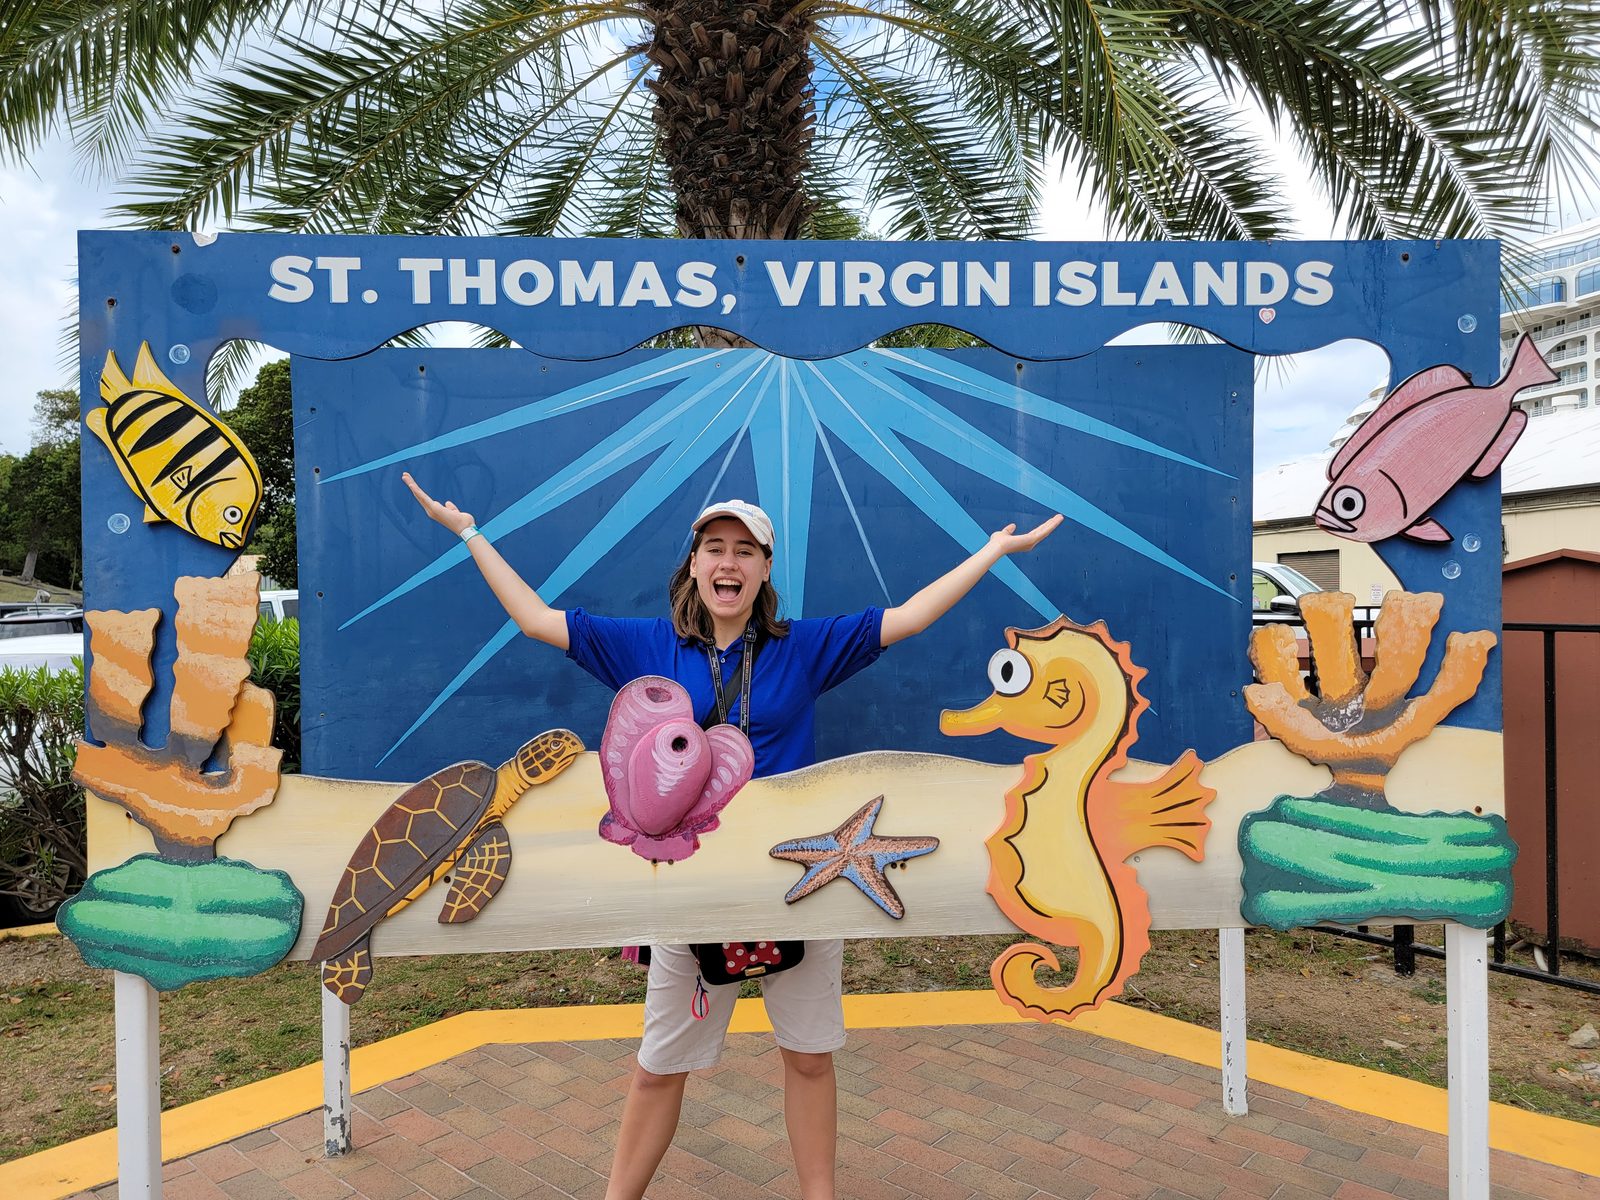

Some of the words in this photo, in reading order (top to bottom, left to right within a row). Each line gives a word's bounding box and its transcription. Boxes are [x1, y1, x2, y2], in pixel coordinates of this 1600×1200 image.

[268, 255, 379, 305] ST.
[398, 257, 737, 315] THOMAS,
[764, 260, 1011, 307] VIRGIN
[1032, 260, 1335, 307] ISLANDS
